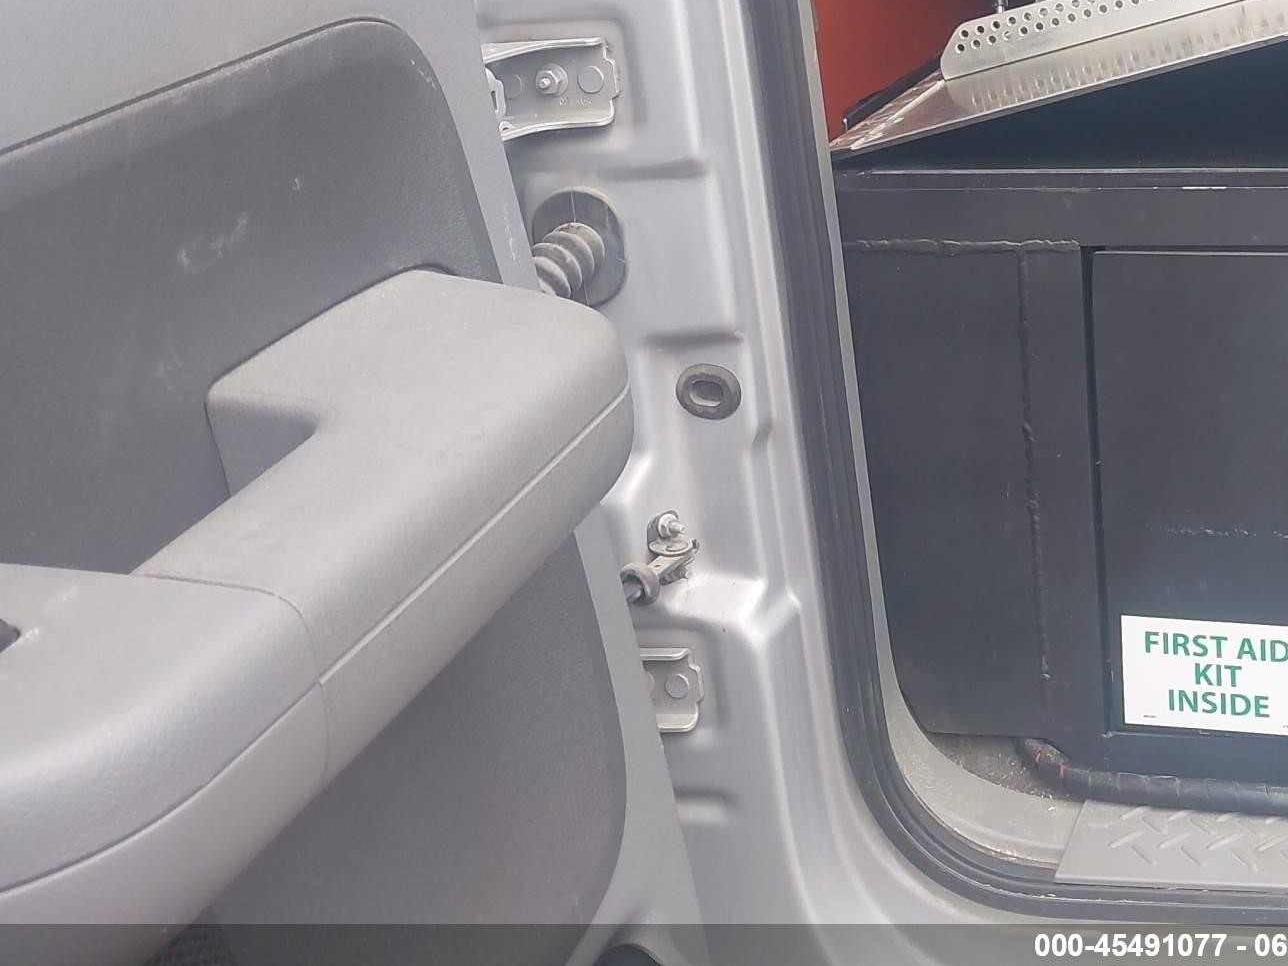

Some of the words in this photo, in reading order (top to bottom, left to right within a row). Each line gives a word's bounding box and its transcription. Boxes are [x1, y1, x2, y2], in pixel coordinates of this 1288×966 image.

[1144, 631, 1228, 659] FIRST
[1194, 663, 1243, 687] KIT
[1168, 689, 1271, 718] INSIDE
